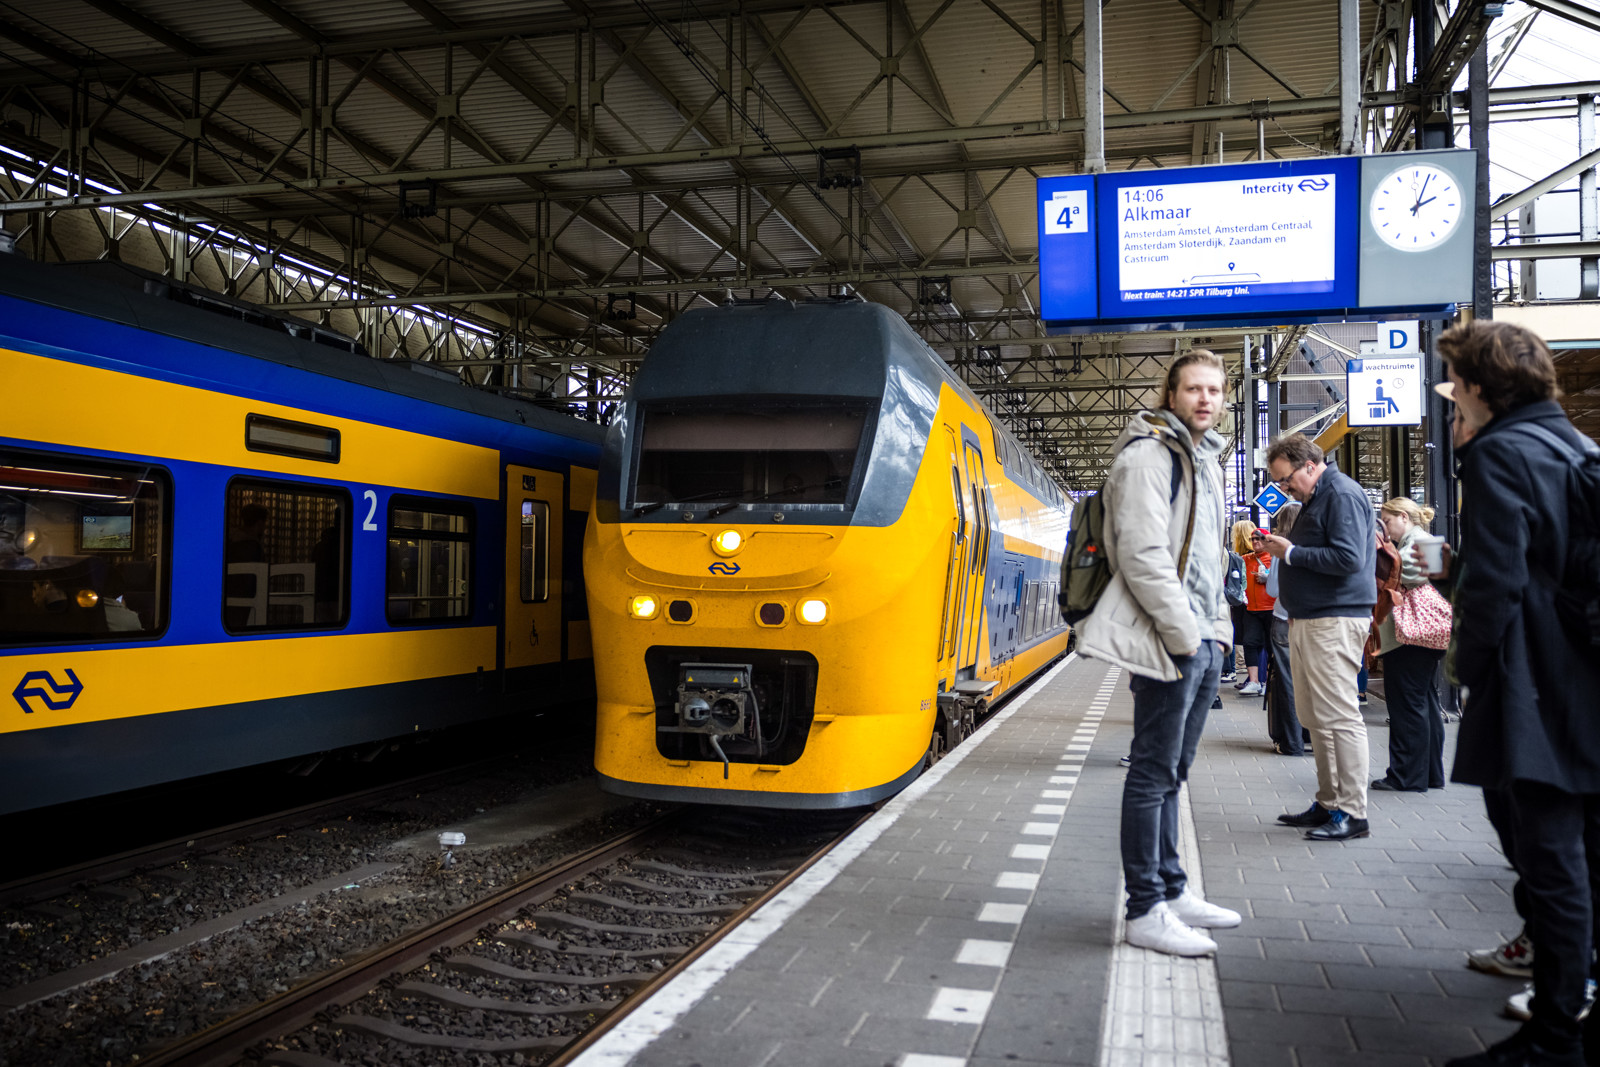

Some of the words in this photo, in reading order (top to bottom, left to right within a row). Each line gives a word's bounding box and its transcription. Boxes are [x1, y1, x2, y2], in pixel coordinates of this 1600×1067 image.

[1124, 188, 1164, 203] 14:06
[1242, 181, 1294, 195] Intercity
[1124, 206, 1192, 222] Alkmaar
[1124, 229, 1176, 239] Amsterdam
[1215, 223, 1269, 234] Amsterdam
[1124, 241, 1176, 251] Amsterdam
[1178, 237, 1226, 249] Sloterdijk,
[1229, 235, 1272, 246] Zaandam
[1274, 235, 1286, 244] en
[1124, 255, 1169, 263] Castricum
[1124, 291, 1143, 300] Next
[1144, 289, 1165, 299] train:
[1167, 289, 1187, 298] 14:21
[1189, 287, 1204, 297] SPR
[1206, 286, 1233, 297] Tilburg
[1234, 285, 1250, 295] Uni.
[1389, 329, 1408, 350] D
[1365, 363, 1416, 371] wachtruimte
[1266, 493, 1278, 507] 2
[363, 489, 378, 531] 2
